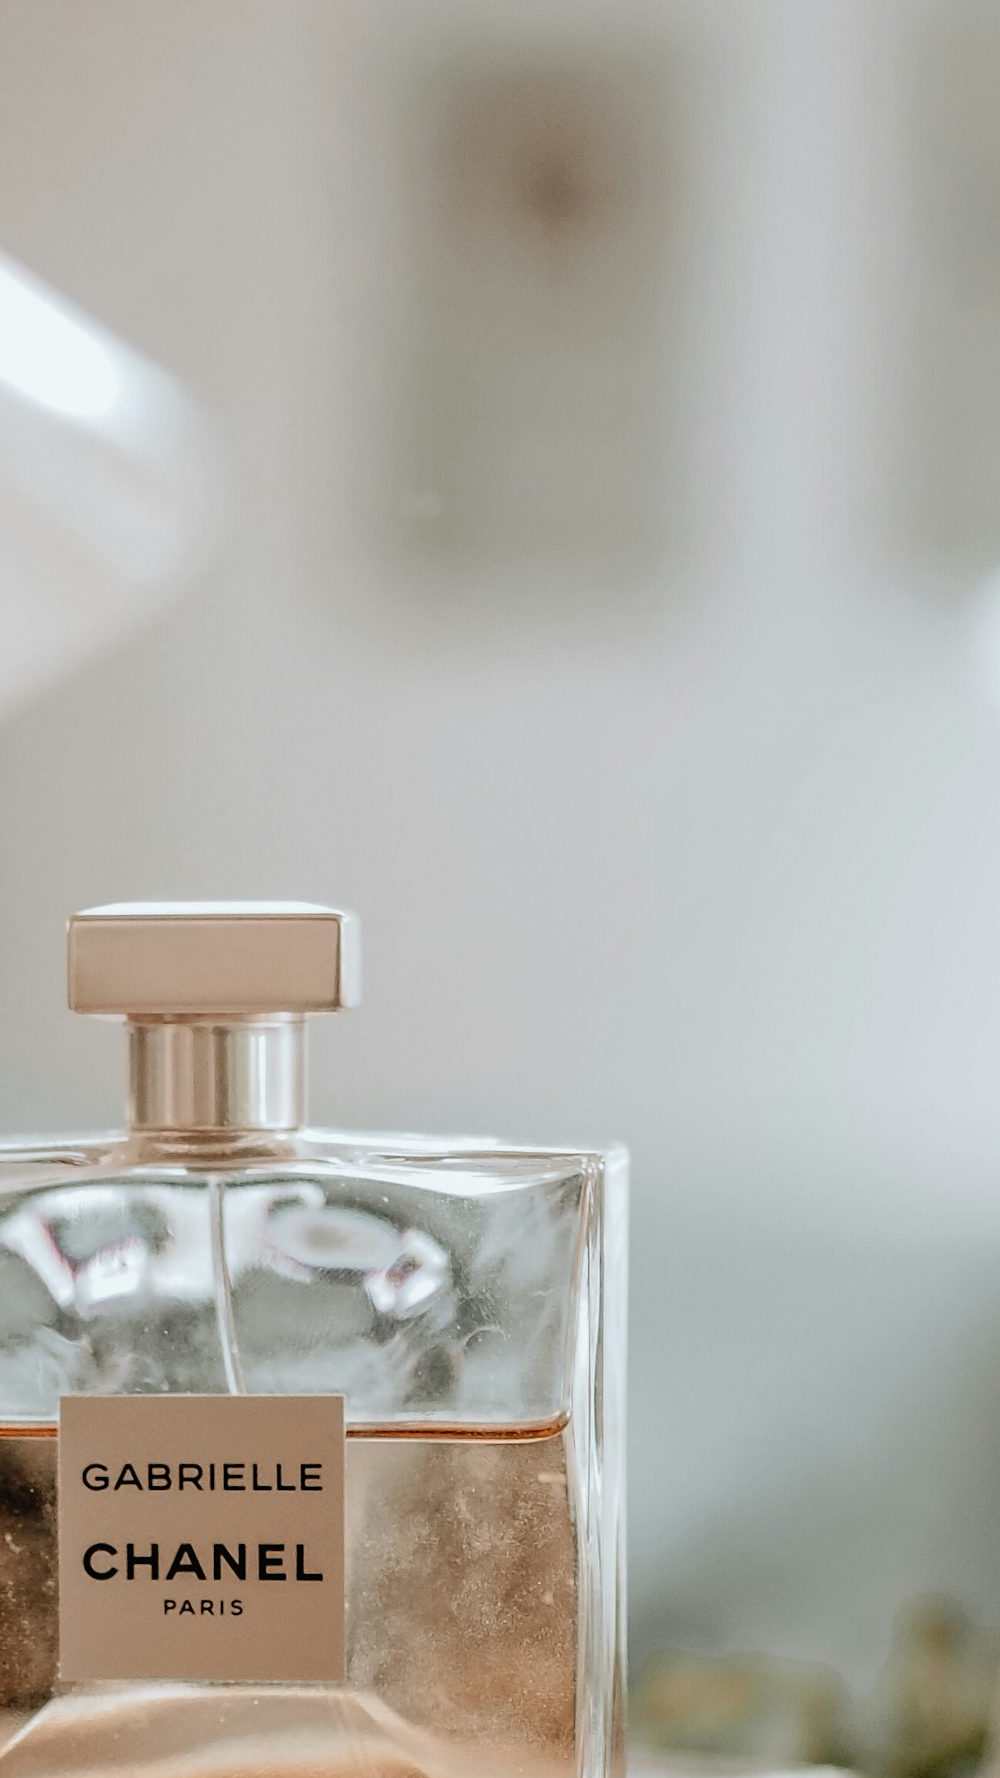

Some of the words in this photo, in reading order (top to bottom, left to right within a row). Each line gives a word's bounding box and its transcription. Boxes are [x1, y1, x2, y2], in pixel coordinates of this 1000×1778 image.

[82, 1463, 323, 1491] GABRIELLE
[83, 1543, 323, 1581] CHANEL
[164, 1600, 243, 1616] PARIS
